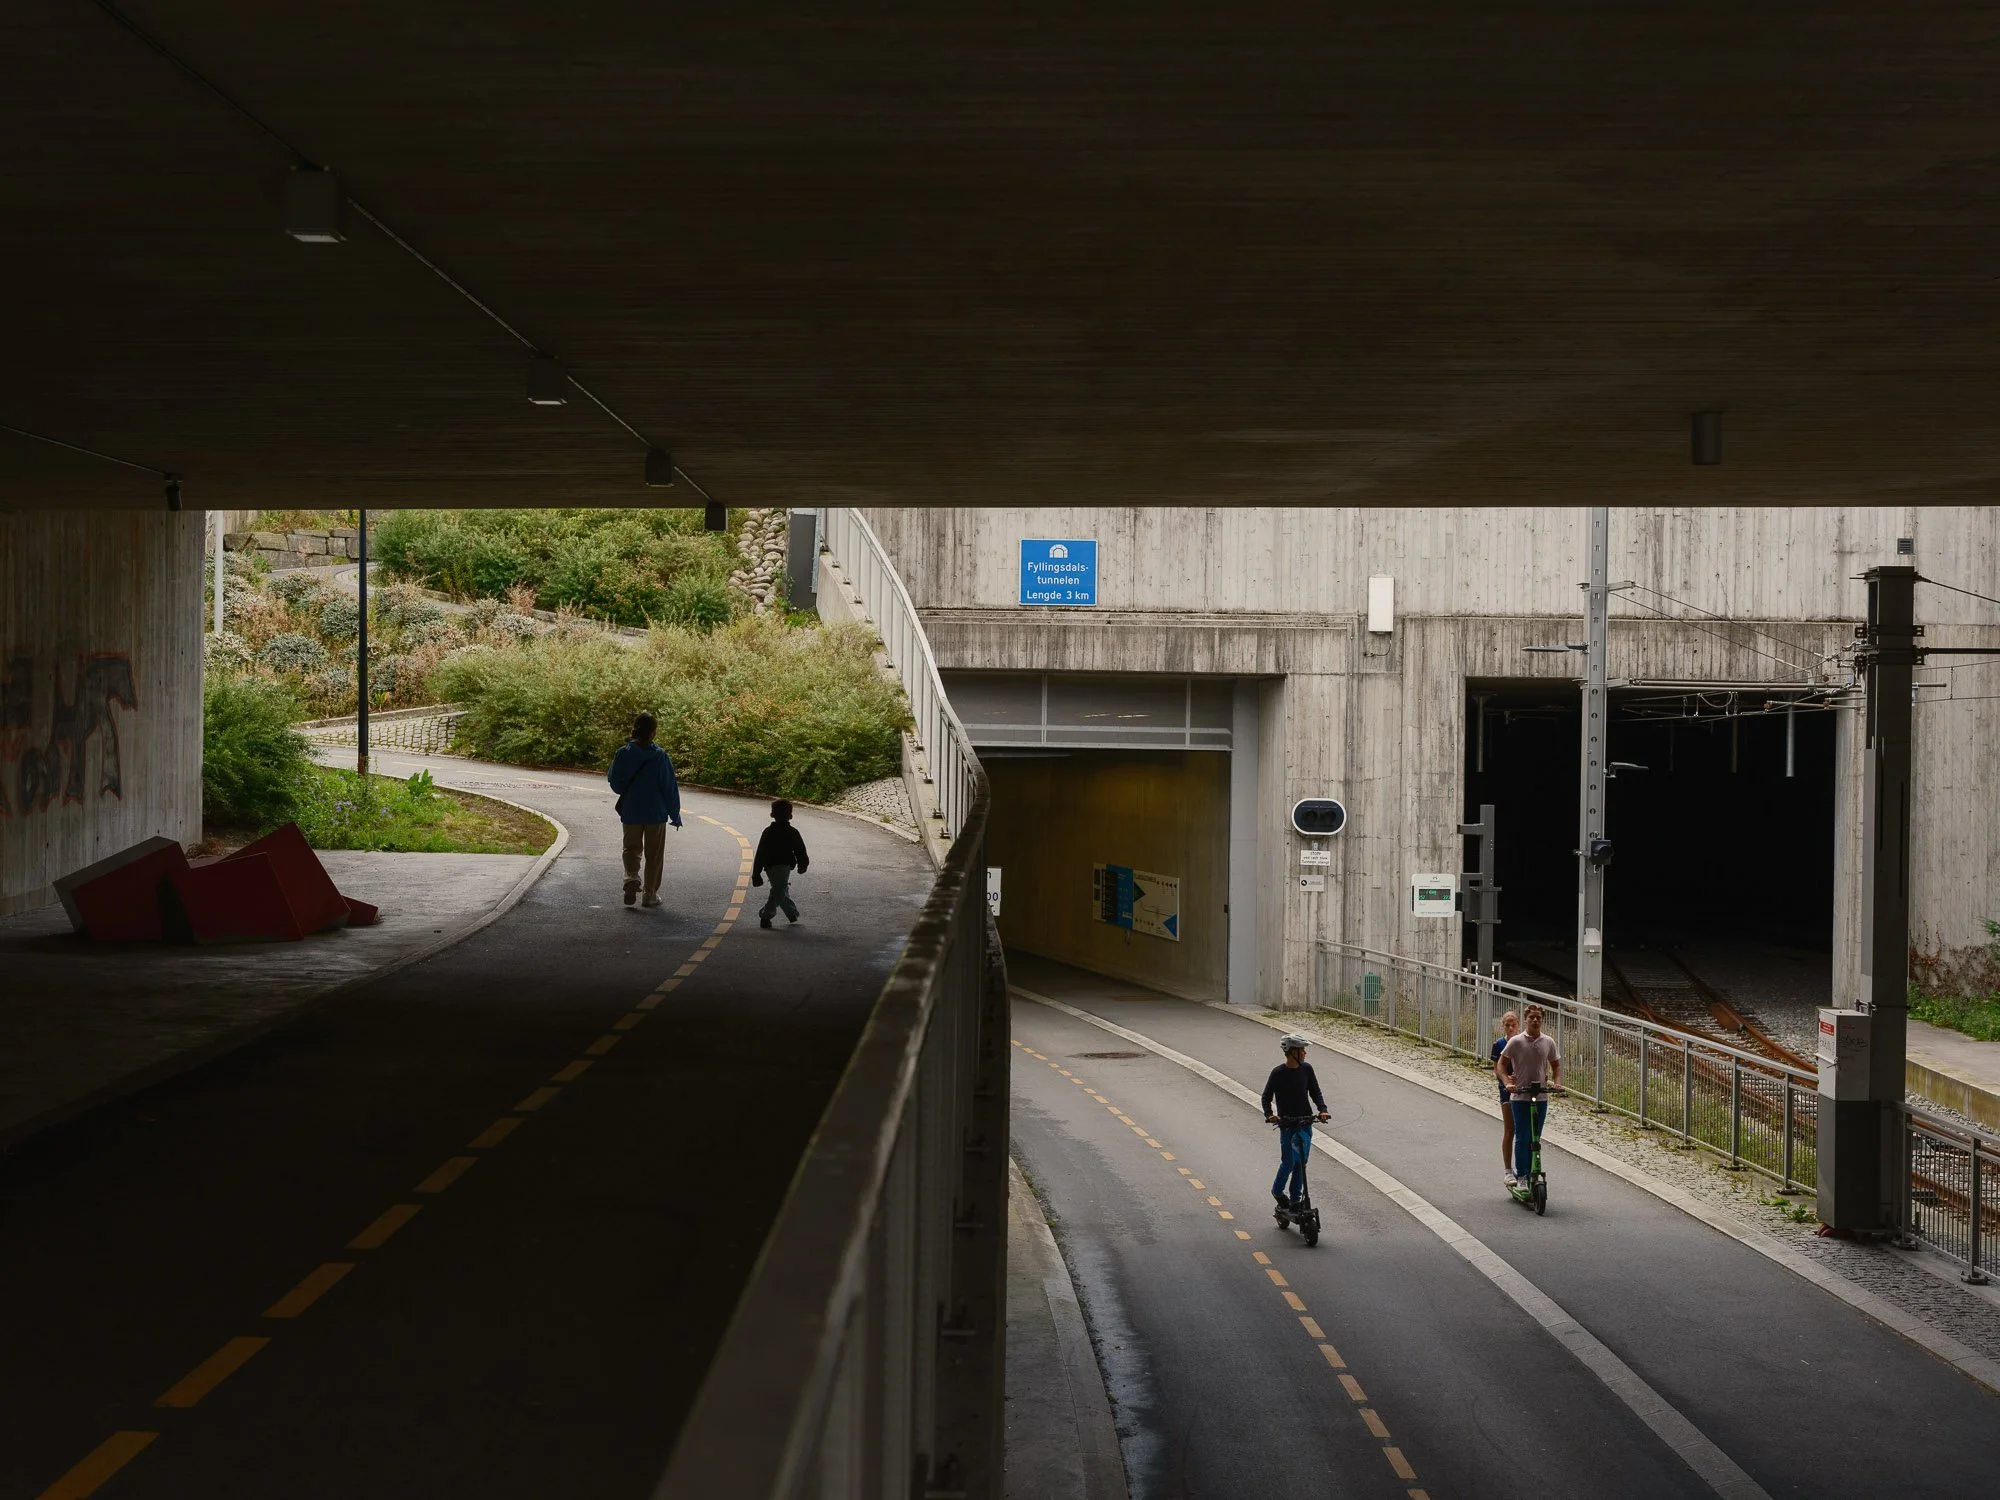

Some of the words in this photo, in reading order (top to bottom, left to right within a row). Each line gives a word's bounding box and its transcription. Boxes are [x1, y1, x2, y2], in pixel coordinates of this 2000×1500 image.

[1027, 562, 1089, 573] Fyllingsdals-
[1037, 575, 1080, 585] tunnelen
[1026, 590, 1062, 601] Lengde
[1066, 590, 1072, 600] 3
[1075, 591, 1089, 600] km
